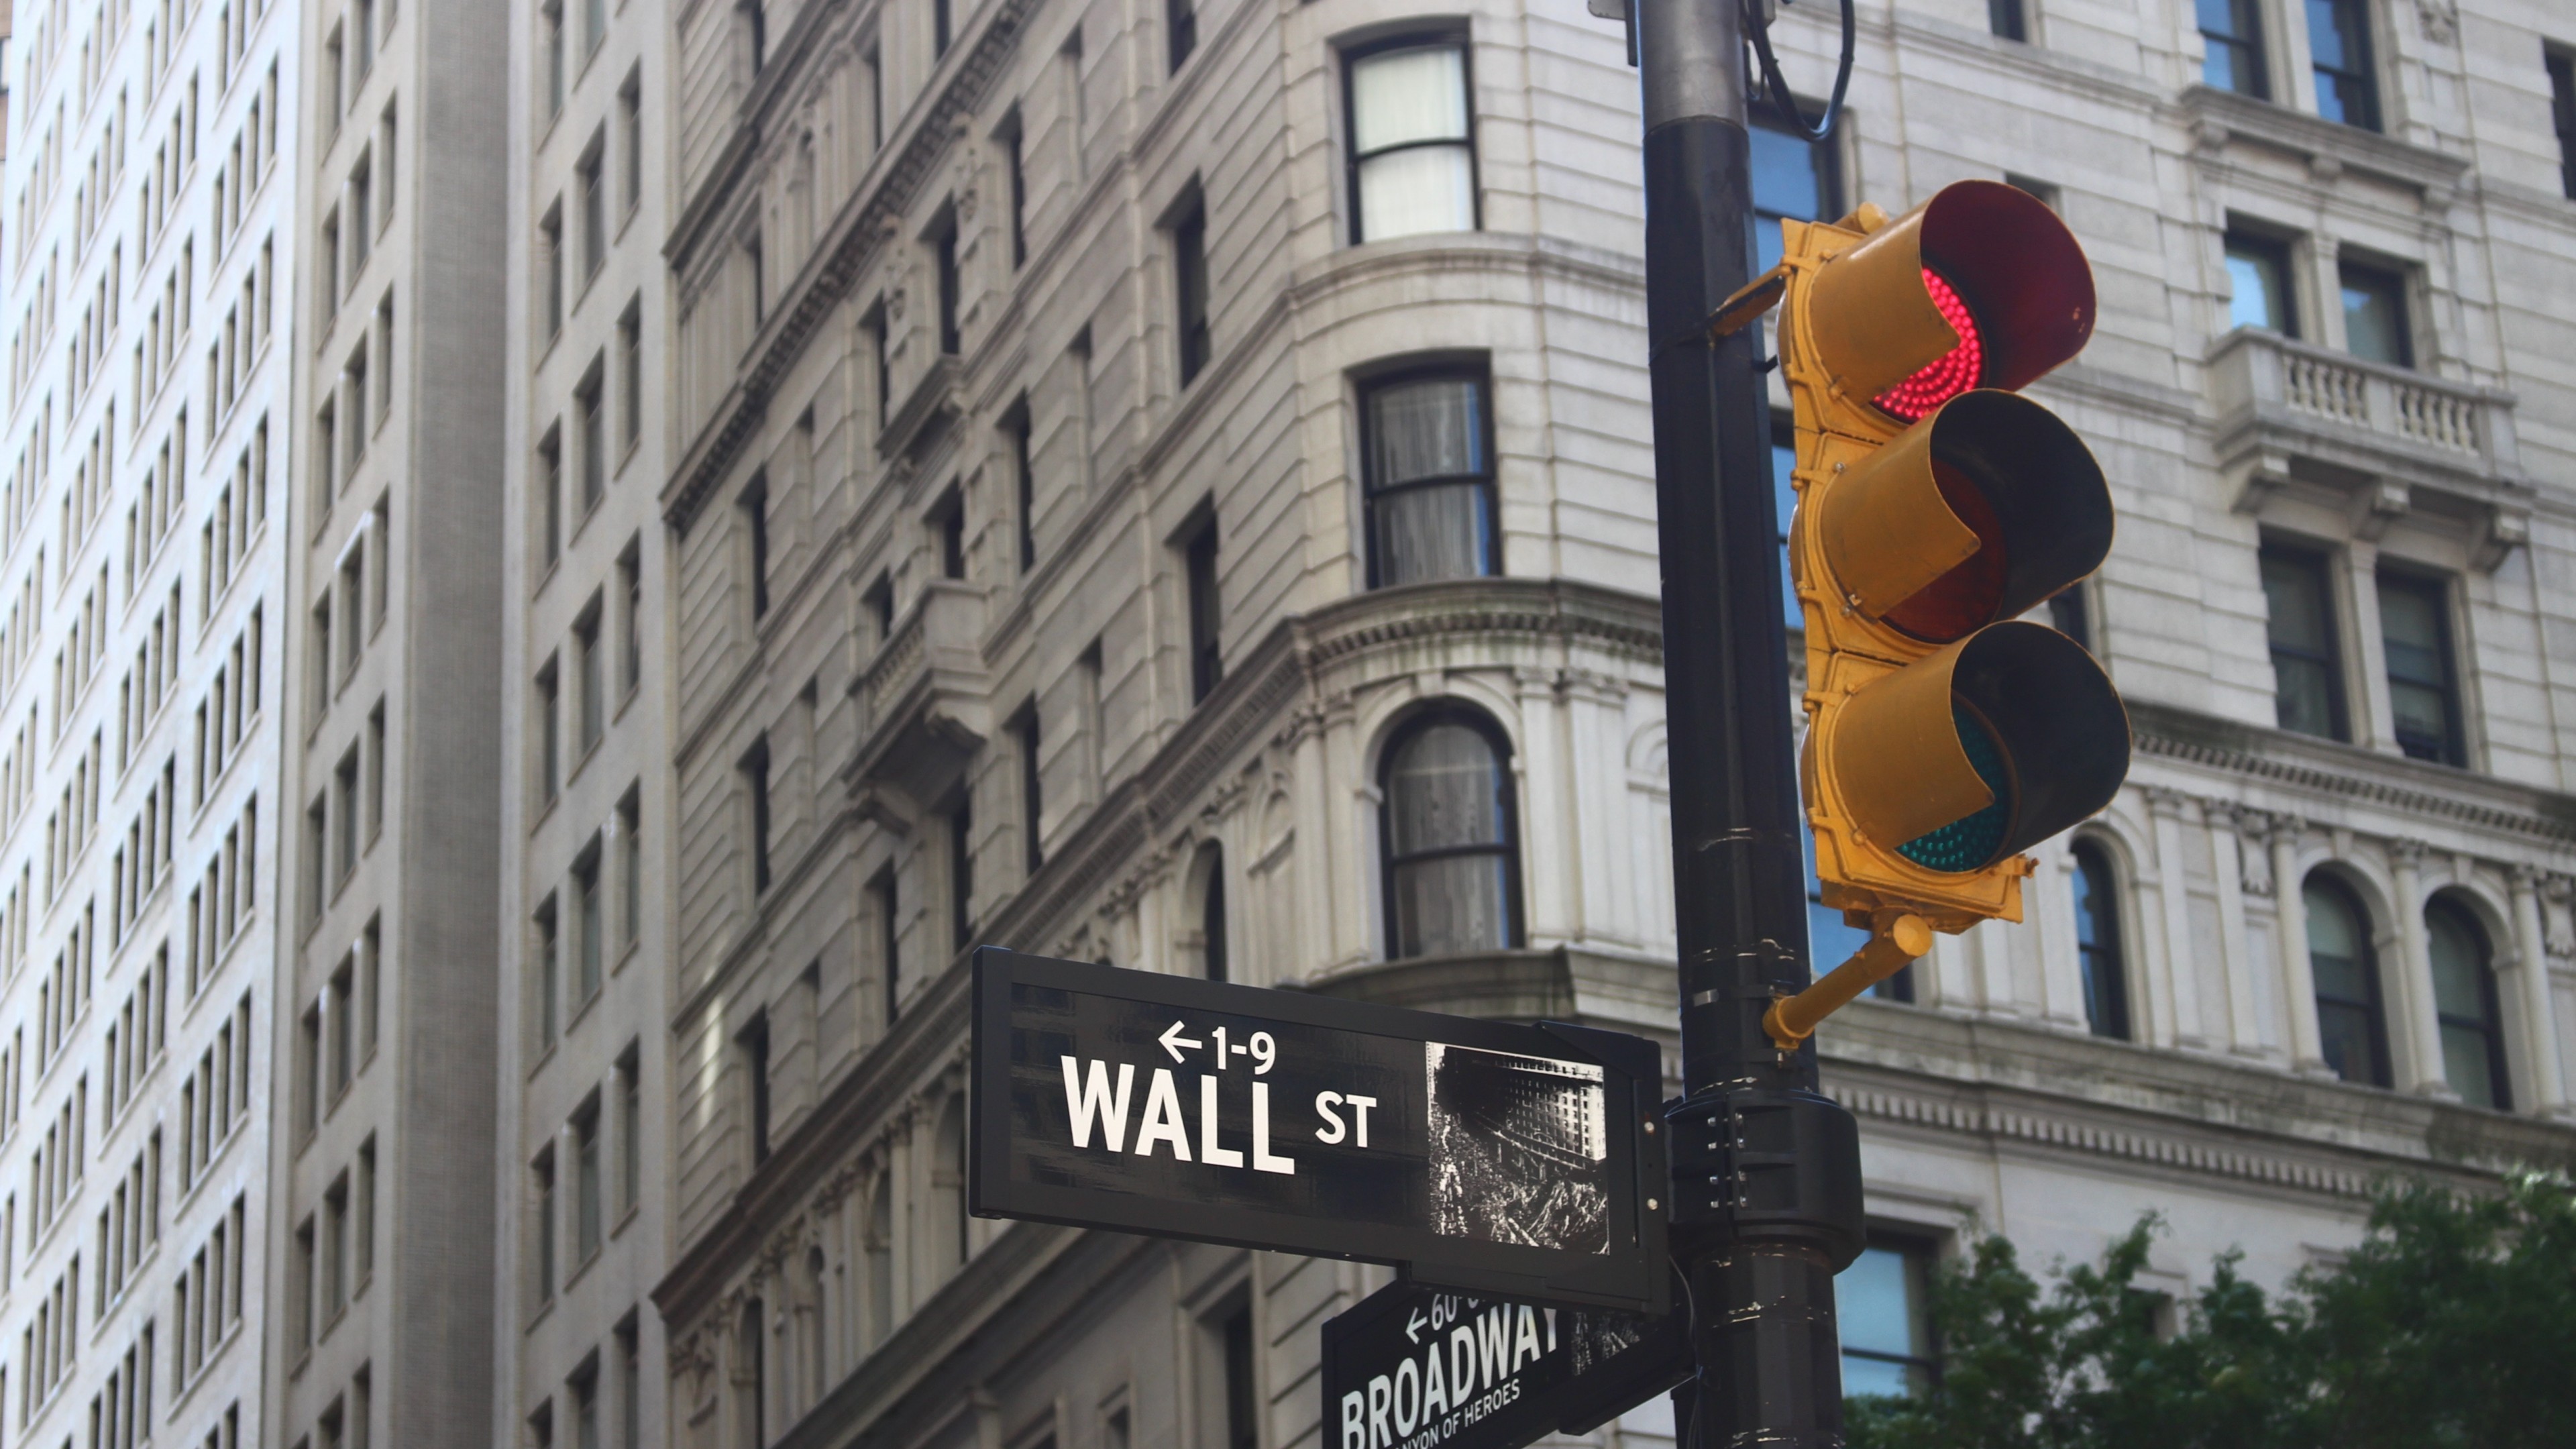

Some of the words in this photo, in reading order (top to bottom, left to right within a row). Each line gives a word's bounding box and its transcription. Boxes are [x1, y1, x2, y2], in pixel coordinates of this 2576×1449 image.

[1212, 1026, 1275, 1075] 1-9
[1061, 1055, 1295, 1175] WALL
[1315, 1090, 1377, 1148] ST
[1442, 1411, 1461, 1439] OF
[1464, 1379, 1520, 1428] HEROES
